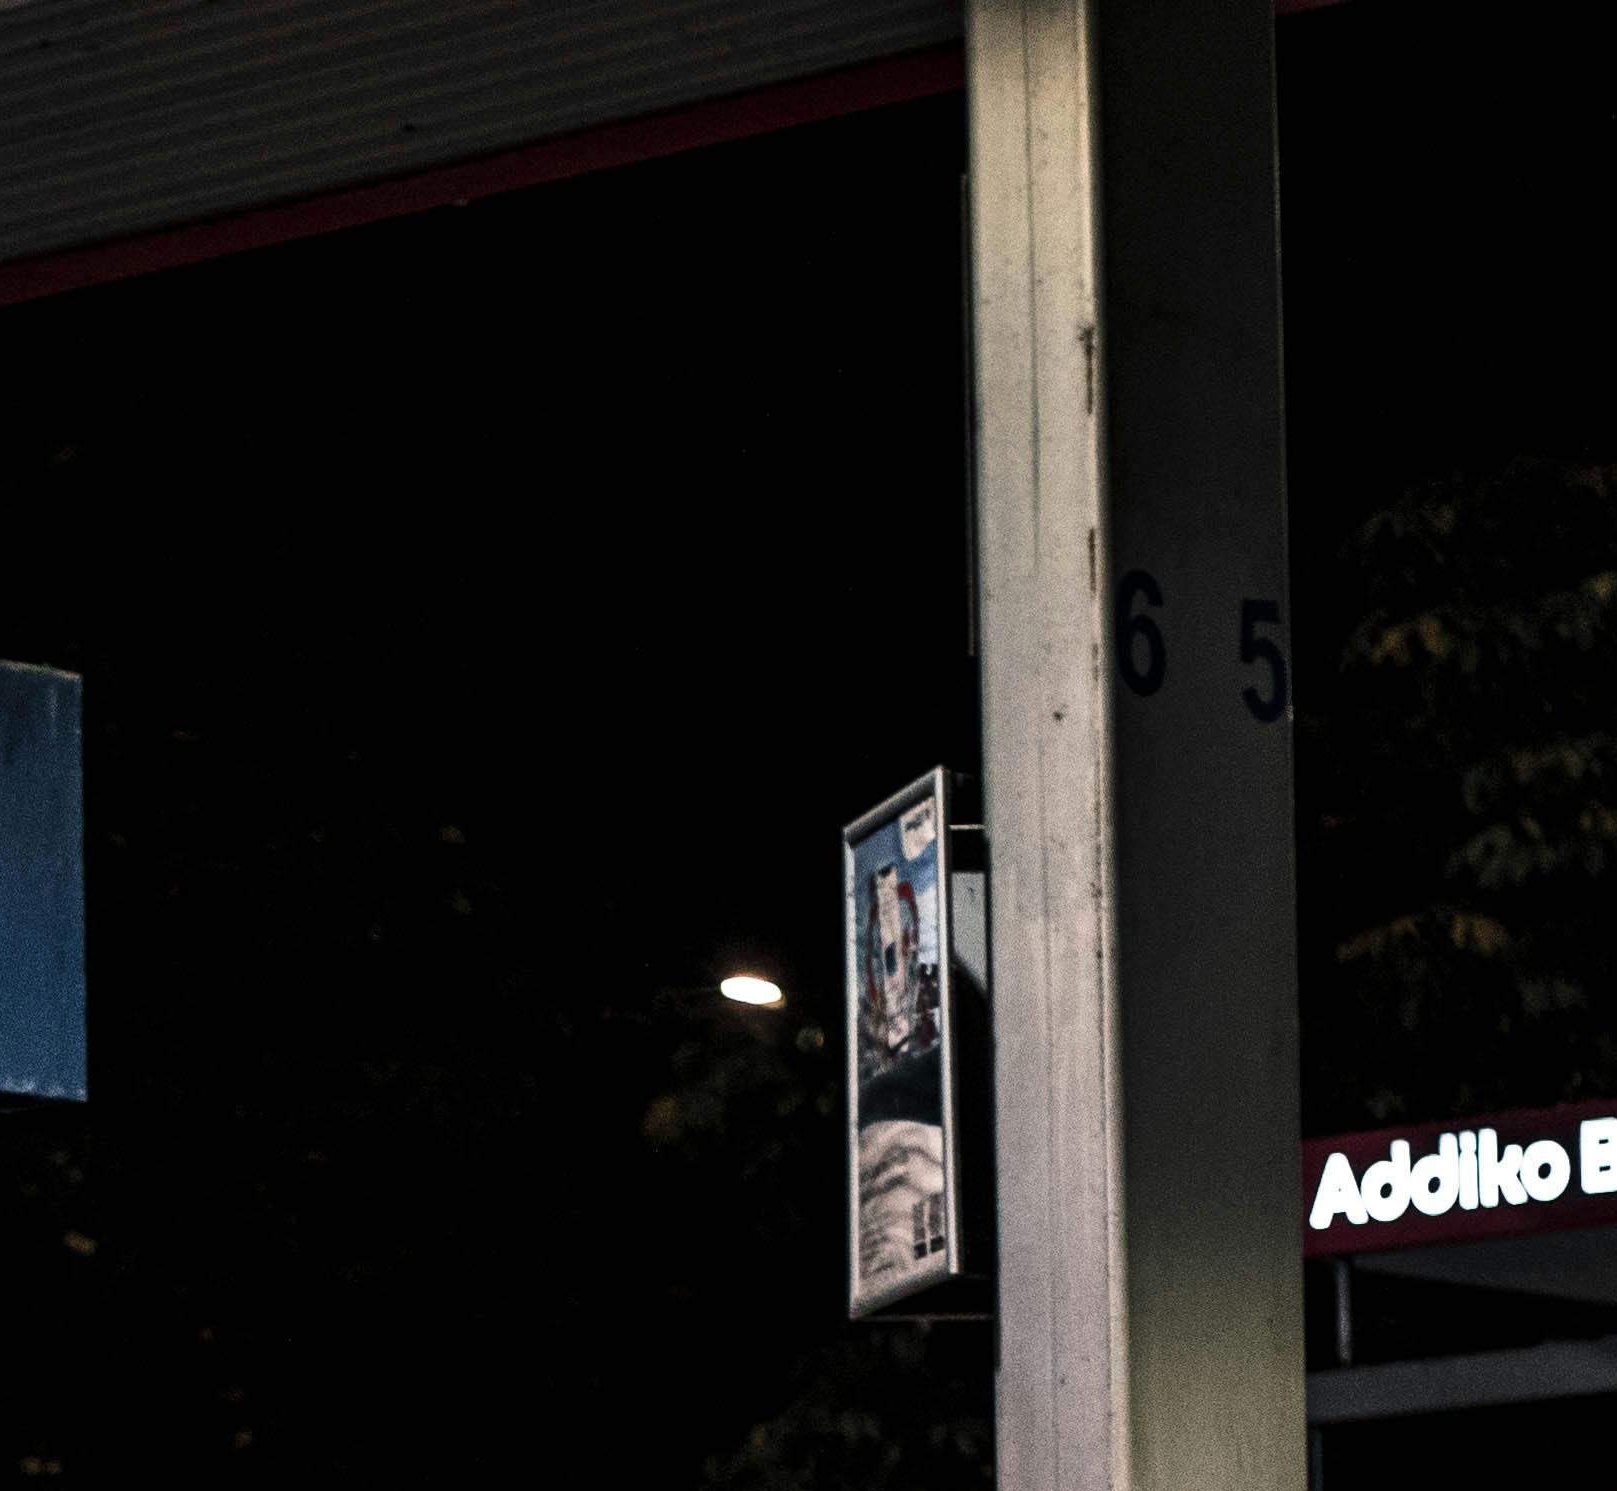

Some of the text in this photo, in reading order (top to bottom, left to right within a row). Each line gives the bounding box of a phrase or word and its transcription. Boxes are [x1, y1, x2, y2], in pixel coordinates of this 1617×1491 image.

[1117, 569, 1287, 723] 6 5
[1308, 1127, 1571, 1230] Addiko
